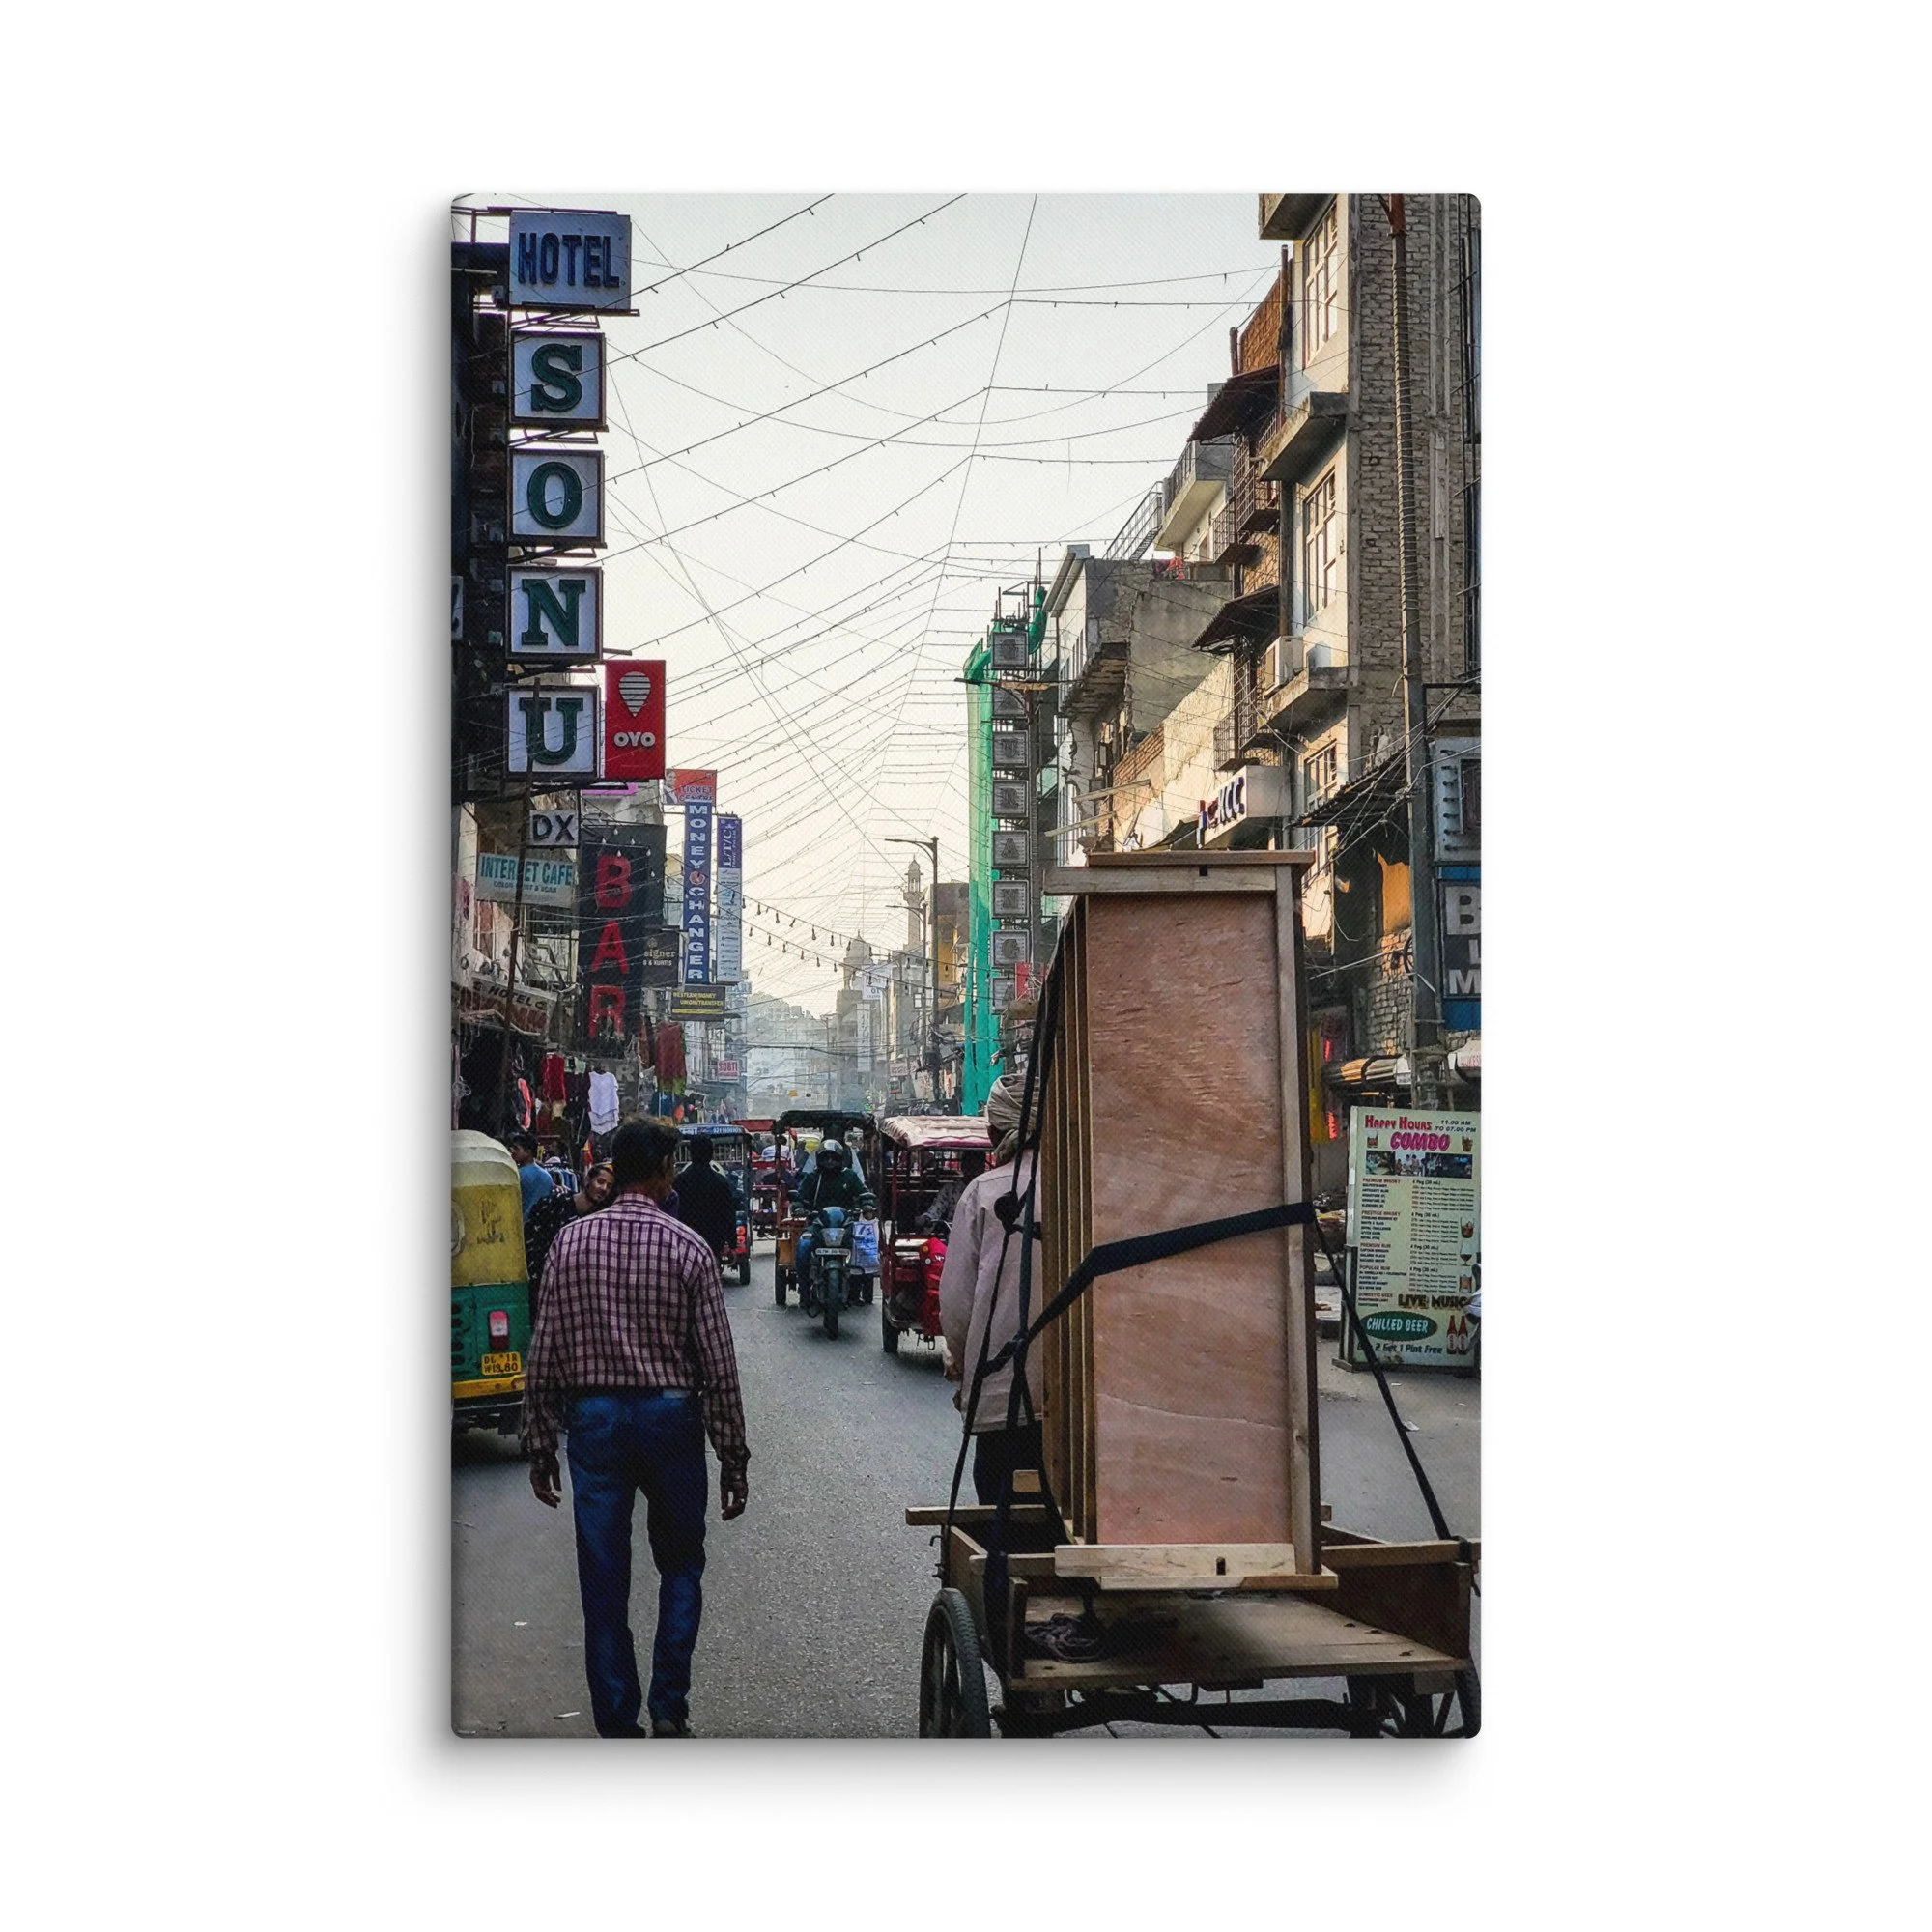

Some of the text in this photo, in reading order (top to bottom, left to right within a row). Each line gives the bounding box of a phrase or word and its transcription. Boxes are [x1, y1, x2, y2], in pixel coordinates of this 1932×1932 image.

[517, 232, 619, 288] HOTEL
[519, 343, 585, 765] SONU
[614, 731, 656, 747] OYO
[532, 814, 575, 841] DX
[689, 805, 708, 868] MONEY
[480, 856, 573, 886] INTERET CAFE
[588, 853, 634, 1039] BAR
[687, 886, 705, 979] CHANGER
[1389, 1131, 1451, 1151] COMBO
[1398, 1293, 1430, 1309] LIVE
[1432, 1295, 1469, 1310] MUSIC
[1366, 1317, 1429, 1333] CHILLED BEER
[1375, 1343, 1382, 1351] 2
[1382, 1343, 1398, 1352] Get
[1399, 1344, 1404, 1352] 1
[1405, 1344, 1424, 1352] Pint
[1424, 1345, 1443, 1354] Free
